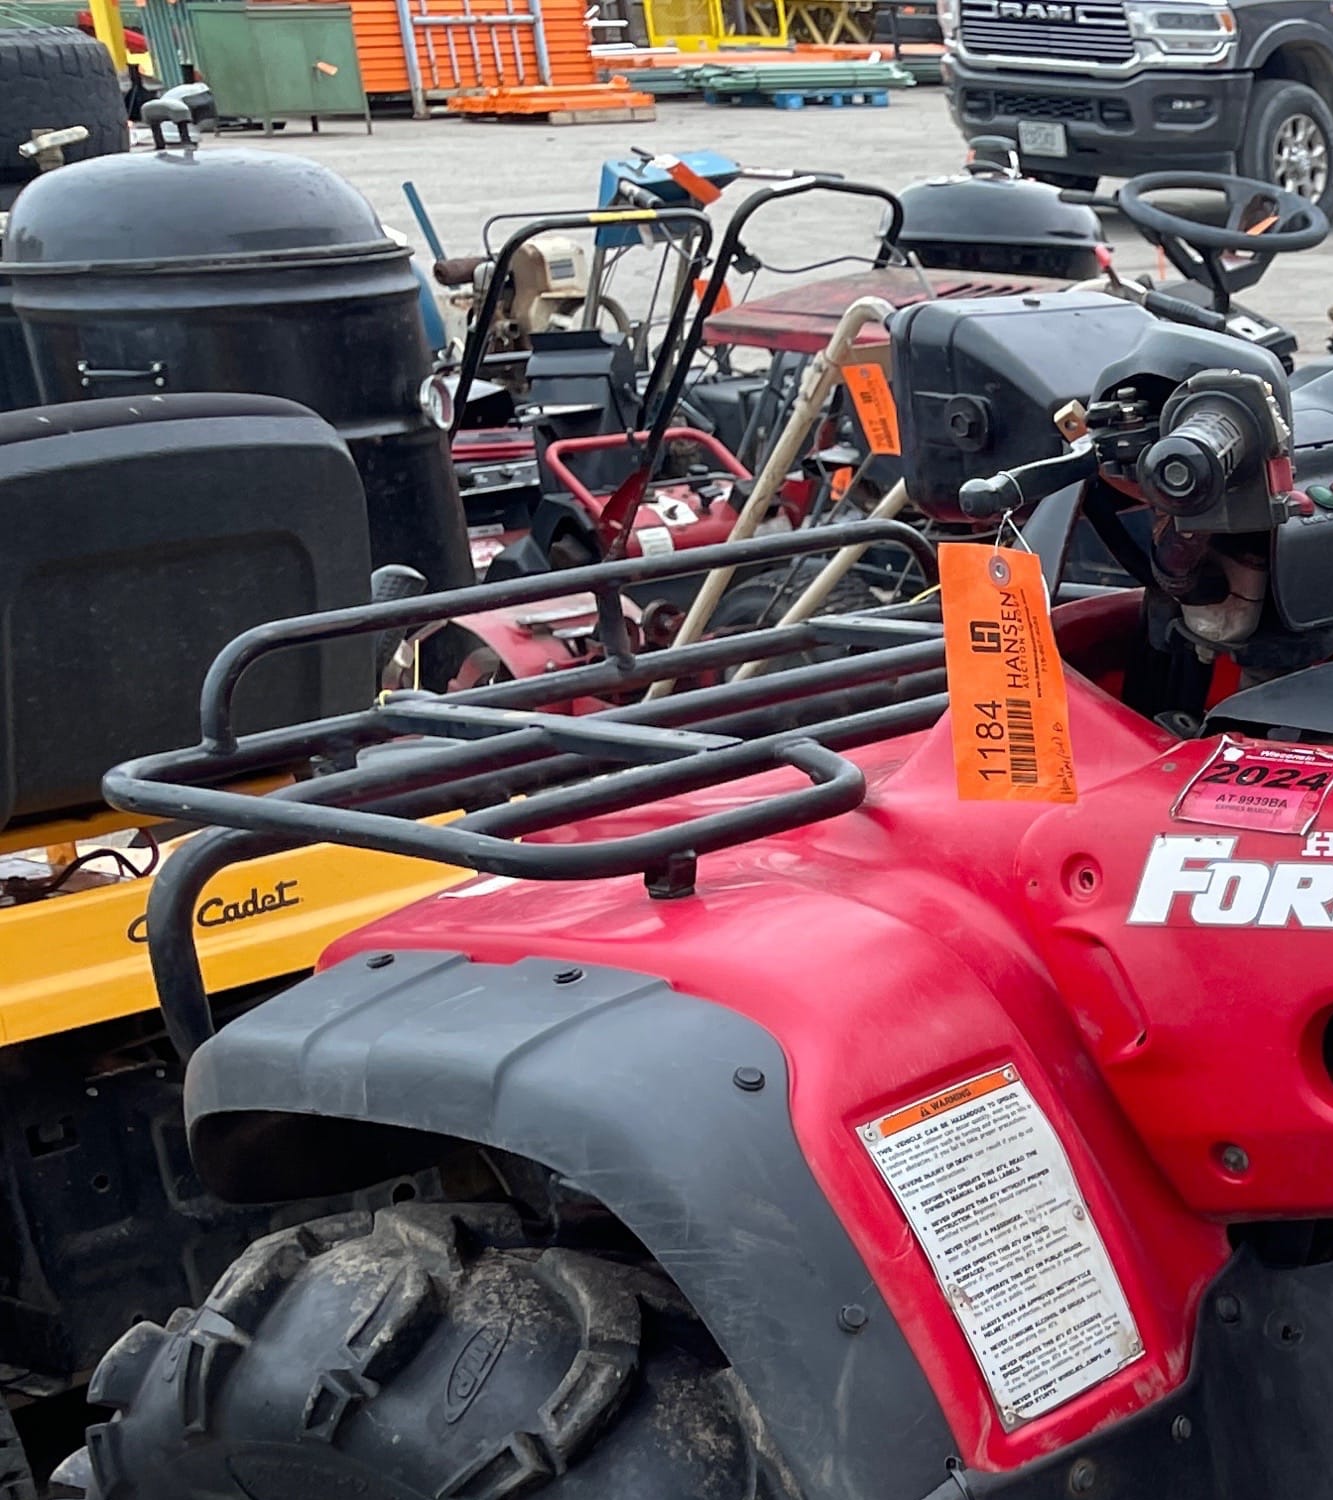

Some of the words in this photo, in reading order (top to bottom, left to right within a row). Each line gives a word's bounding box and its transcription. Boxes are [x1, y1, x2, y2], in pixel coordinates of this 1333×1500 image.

[1000, 4, 1072, 20] RAM
[1000, 591, 1023, 688] HANSEN
[1019, 637, 1030, 689] AUCTION
[974, 700, 1007, 781] 1184
[1201, 763, 1331, 791] 2024
[1216, 793, 1237, 803] AT
[1238, 794, 1288, 809] 9939BA
[197, 880, 299, 927] Cadet
[930, 1088, 972, 1110] WARNING
[878, 1146, 892, 1156] THIS
[896, 1134, 922, 1148] VEHICLE
[924, 1126, 938, 1136] CAN
[950, 1106, 986, 1124] HAZARDOUS
[898, 1176, 924, 1192] SEVERE
[924, 1166, 944, 1180] INJURY
[954, 1154, 974, 1166] DEATH
[920, 1192, 944, 1208] BEFORE
[944, 1186, 956, 1196] YOU
[958, 1176, 982, 1190] OPERATE
[982, 1170, 994, 1178] THIS
[1008, 1156, 1024, 1166] READ
[1026, 1150, 1038, 1158] THE
[974, 1182, 986, 1190] AND
[988, 1176, 998, 1186] ALL
[930, 1214, 950, 1228] NEVER
[950, 1204, 974, 1218] OPERATE
[976, 1196, 988, 1206] THIS
[990, 1192, 1000, 1200] ATV
[944, 1242, 962, 1256] NEVER
[964, 1234, 982, 1246] CARRY
[952, 1264, 972, 1276] NEVER
[972, 1250, 996, 1266] OPERATE
[998, 1244, 1010, 1254] THIS
[1010, 1238, 1022, 1248] ATV
[986, 1278, 1010, 1294] OPERATE
[1010, 1272, 1022, 1282] THIS
[1024, 1266, 1034, 1274] ATV
[1018, 1304, 1026, 1312] AN
[990, 1338, 1008, 1350] NEVER
[998, 1358, 1018, 1372] NEVER
[1018, 1346, 1042, 1362] OPERATE
[1042, 1338, 1054, 1348] THIS
[1054, 1332, 1064, 1342] ATV
[1012, 1392, 1032, 1406] NEVER
